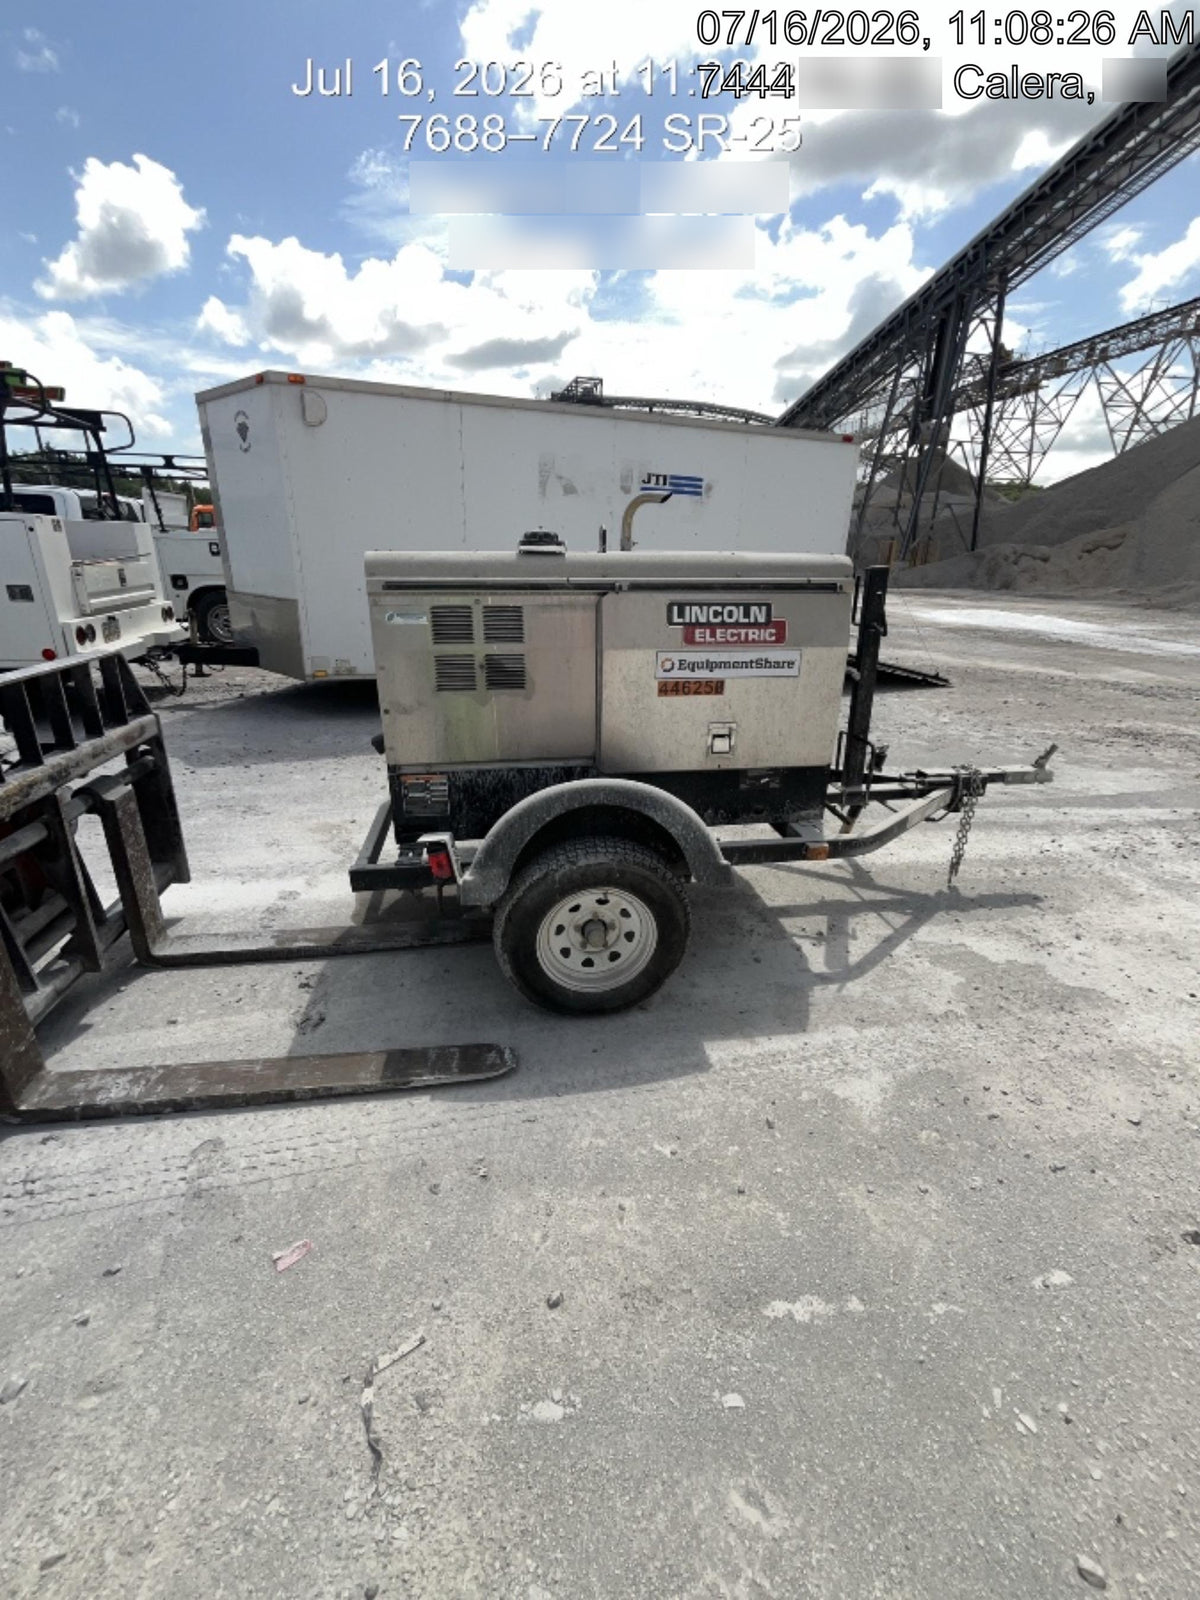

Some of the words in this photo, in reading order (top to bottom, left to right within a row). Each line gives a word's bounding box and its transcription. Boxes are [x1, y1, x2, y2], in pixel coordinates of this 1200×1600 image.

[672, 605, 767, 624] LINCOLN
[694, 628, 777, 643] ELECTRIC
[677, 657, 796, 673] EquipmentShare
